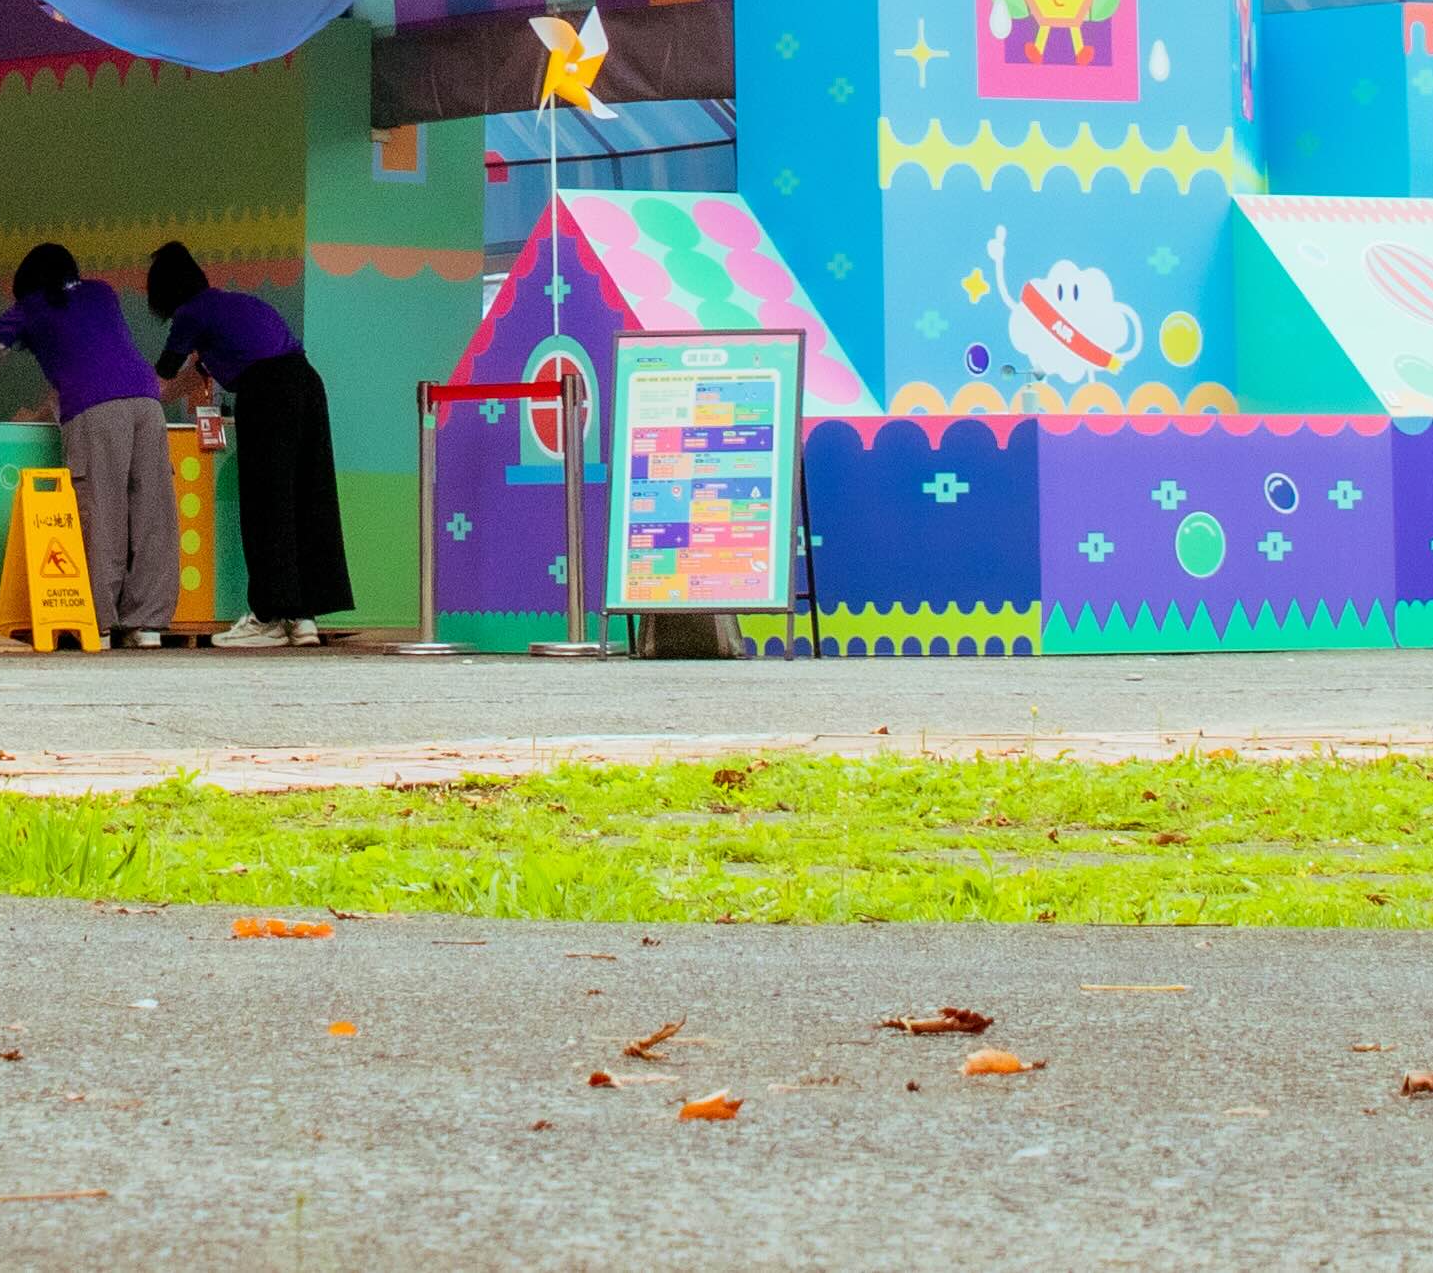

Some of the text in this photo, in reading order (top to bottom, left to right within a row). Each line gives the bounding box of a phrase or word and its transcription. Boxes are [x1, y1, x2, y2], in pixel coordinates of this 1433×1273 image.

[1051, 320, 1074, 343] AIR
[33, 513, 74, 529] 小心地滑
[47, 589, 79, 598] CAUTION
[42, 598, 86, 607] WET FLOOR
